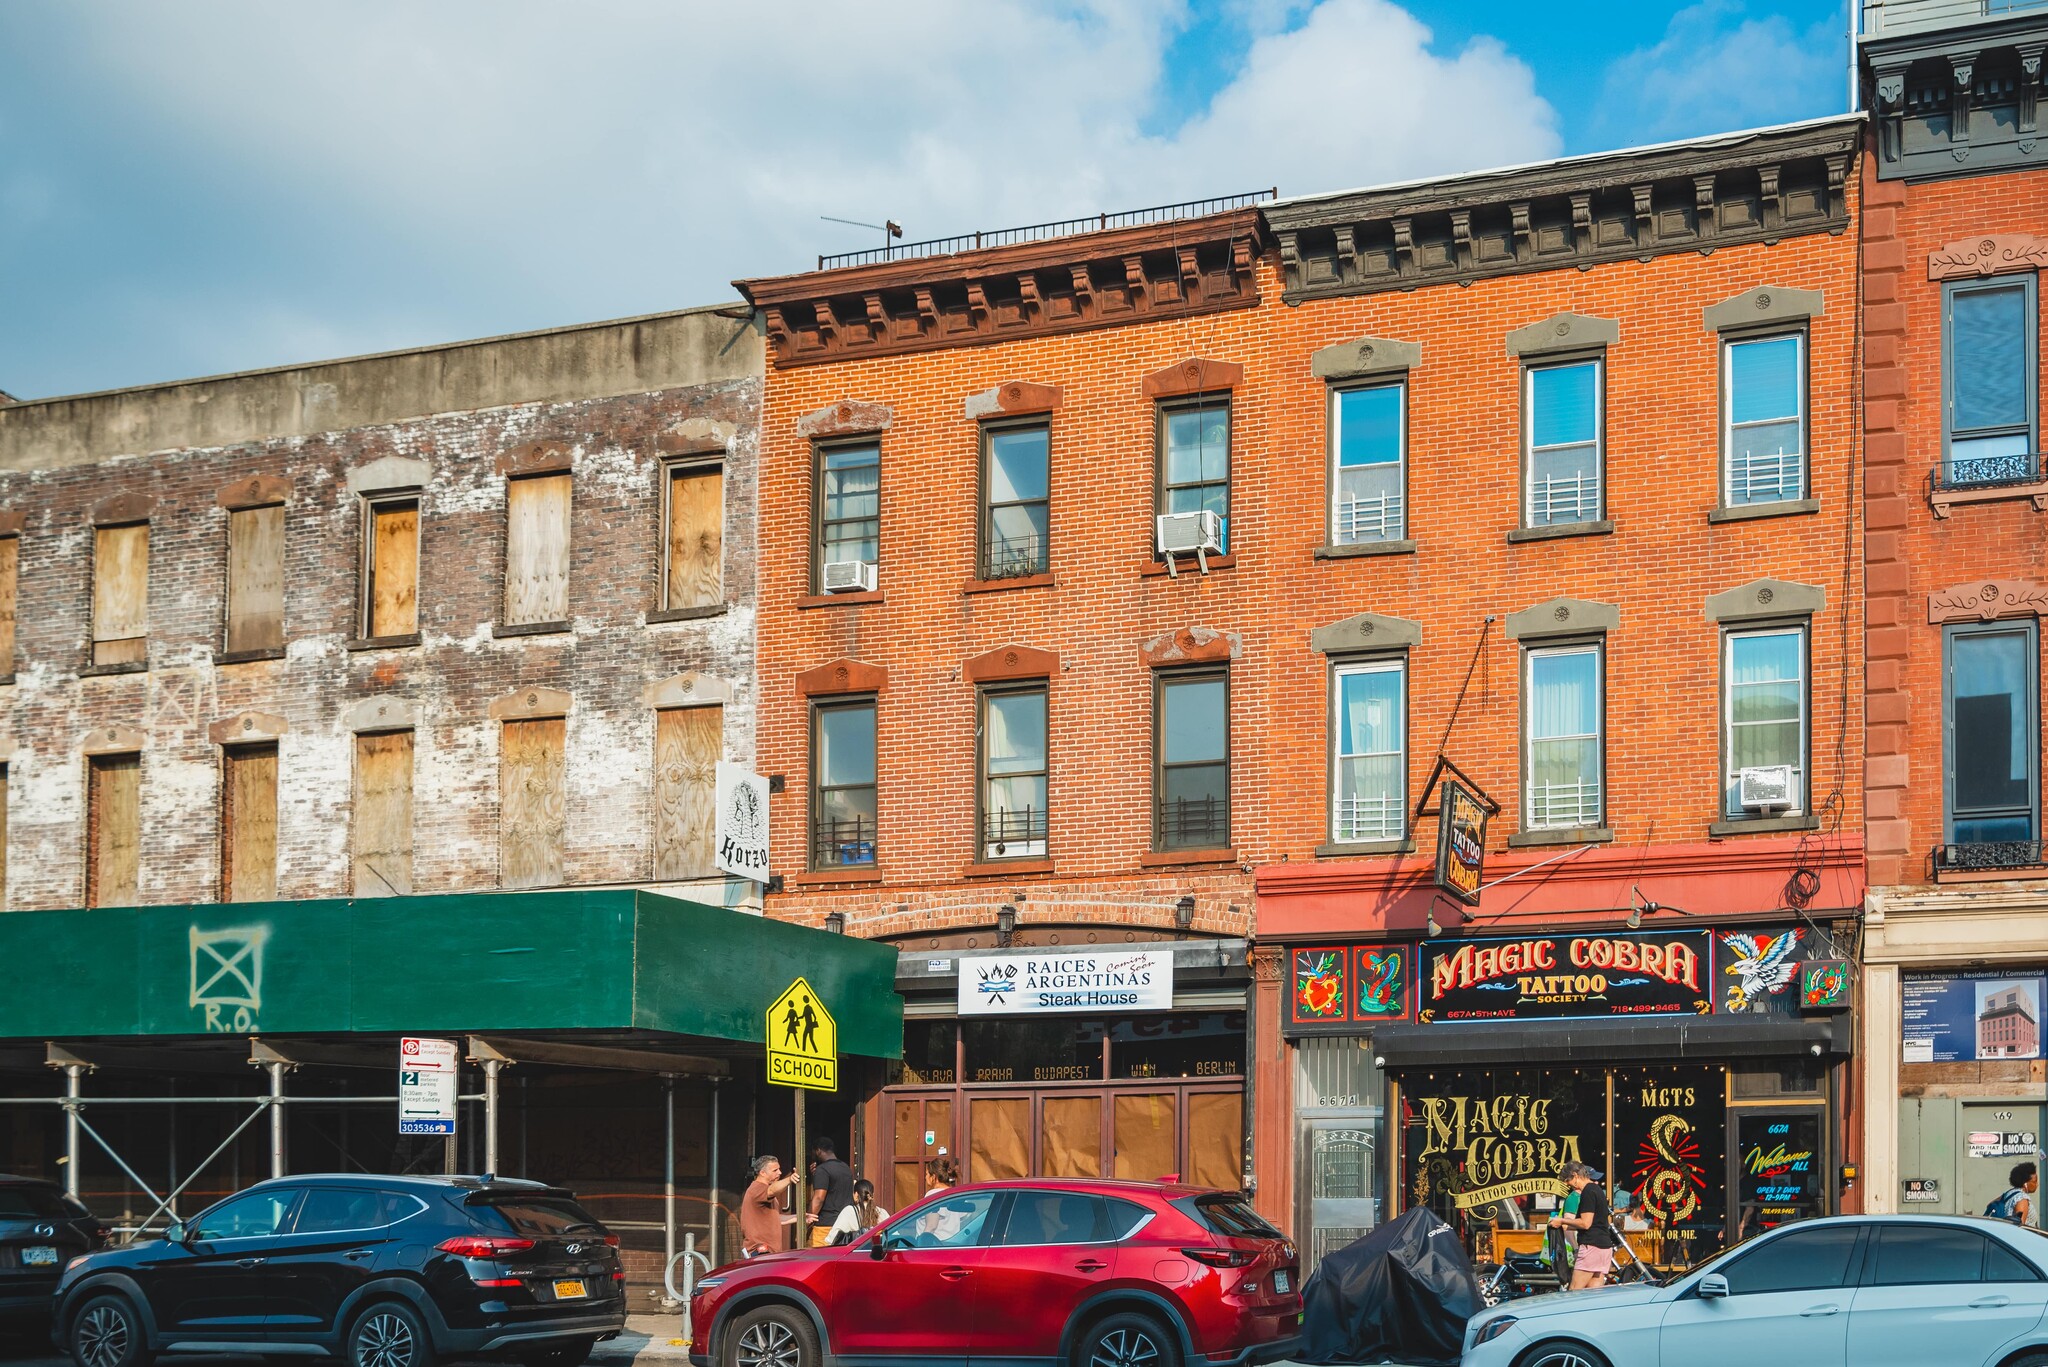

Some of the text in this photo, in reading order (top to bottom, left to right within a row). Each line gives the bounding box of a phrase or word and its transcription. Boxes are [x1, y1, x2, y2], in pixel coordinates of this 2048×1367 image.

[720, 834, 768, 868] Korzo
[1454, 828, 1481, 860] TATTOO
[1449, 851, 1479, 895] COBRA
[1027, 960, 1096, 974] RAICES
[1106, 953, 1147, 973] Coming
[1129, 961, 1156, 975] Soon
[1431, 938, 1702, 1001] MAGIC COBRA
[1930, 973, 1958, 982] Progress
[1963, 971, 1999, 979] Residential
[2005, 969, 2045, 977] Commercial
[1517, 974, 1608, 995] TATTOO
[1038, 991, 1138, 1007] Steak House
[1537, 994, 1588, 1004] SOCIETY
[205, 1002, 259, 1032] R.O.
[773, 1058, 832, 1080] SCHOOL
[977, 1067, 1013, 1081] PRAHA
[1034, 1065, 1090, 1080] BUDAPEST
[1196, 1061, 1236, 1075] BERLIN
[405, 1072, 415, 1085] 2
[1320, 1096, 1355, 1106] 667A
[1641, 1087, 1695, 1107] MCTS
[402, 1123, 435, 1132] 303536
[1418, 1095, 1552, 1163] MAGIC
[1768, 1124, 1790, 1134] 667A
[2007, 1134, 2019, 1144] NO
[2003, 1143, 2037, 1154] SMOKING
[1465, 1135, 1583, 1186] COBRA
[1744, 1143, 1812, 1175] Welcome
[1791, 1161, 1809, 1171] ALL
[1467, 1180, 1555, 1205] TATTOO SOCIETY
[1756, 1186, 1801, 1194] OPEN 7 DAYS
[1910, 1182, 1921, 1190] NO
[1906, 1191, 1938, 1200] SMOKING
[1666, 1229, 1679, 1240] OR
